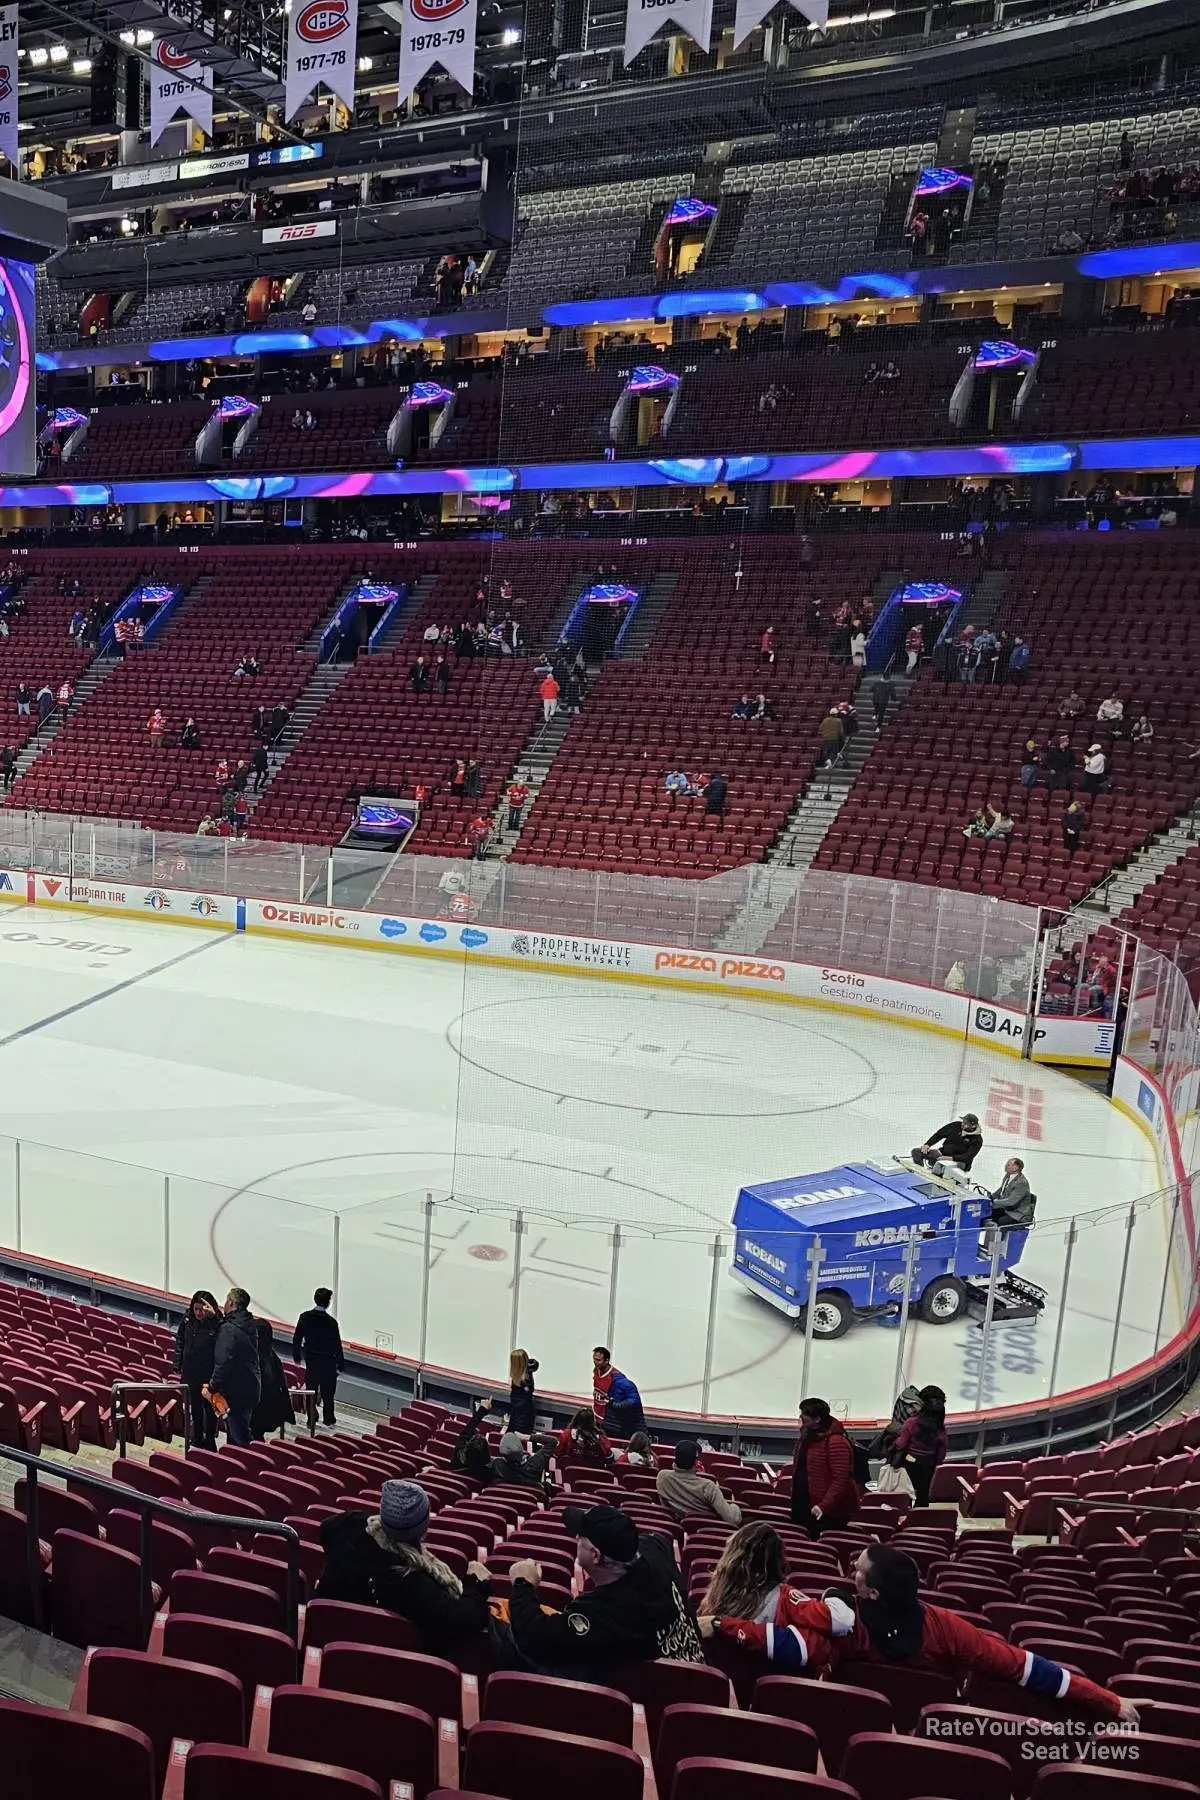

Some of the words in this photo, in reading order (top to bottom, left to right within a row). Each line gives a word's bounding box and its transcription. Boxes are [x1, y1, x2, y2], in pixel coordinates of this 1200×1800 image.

[410, 29, 466, 52] 1978-79
[296, 50, 346, 72] 1977-78
[280, 225, 318, 240] RDS
[958, 346, 971, 354] 215
[1042, 340, 1057, 349] 216
[108, 889, 126, 903] TIRE
[532, 936, 578, 952] PROPER
[584, 941, 632, 959] TWELVE
[532, 949, 567, 959] IRISH
[574, 954, 632, 967] WHISKEY
[655, 951, 717, 972] pizza
[720, 958, 786, 981] pizza
[821, 969, 865, 988] Scotia
[820, 983, 863, 1003] Gestion
[864, 991, 879, 1005] de
[855, 1222, 931, 1247] KOBALT
[744, 1239, 787, 1274] KOBALT
